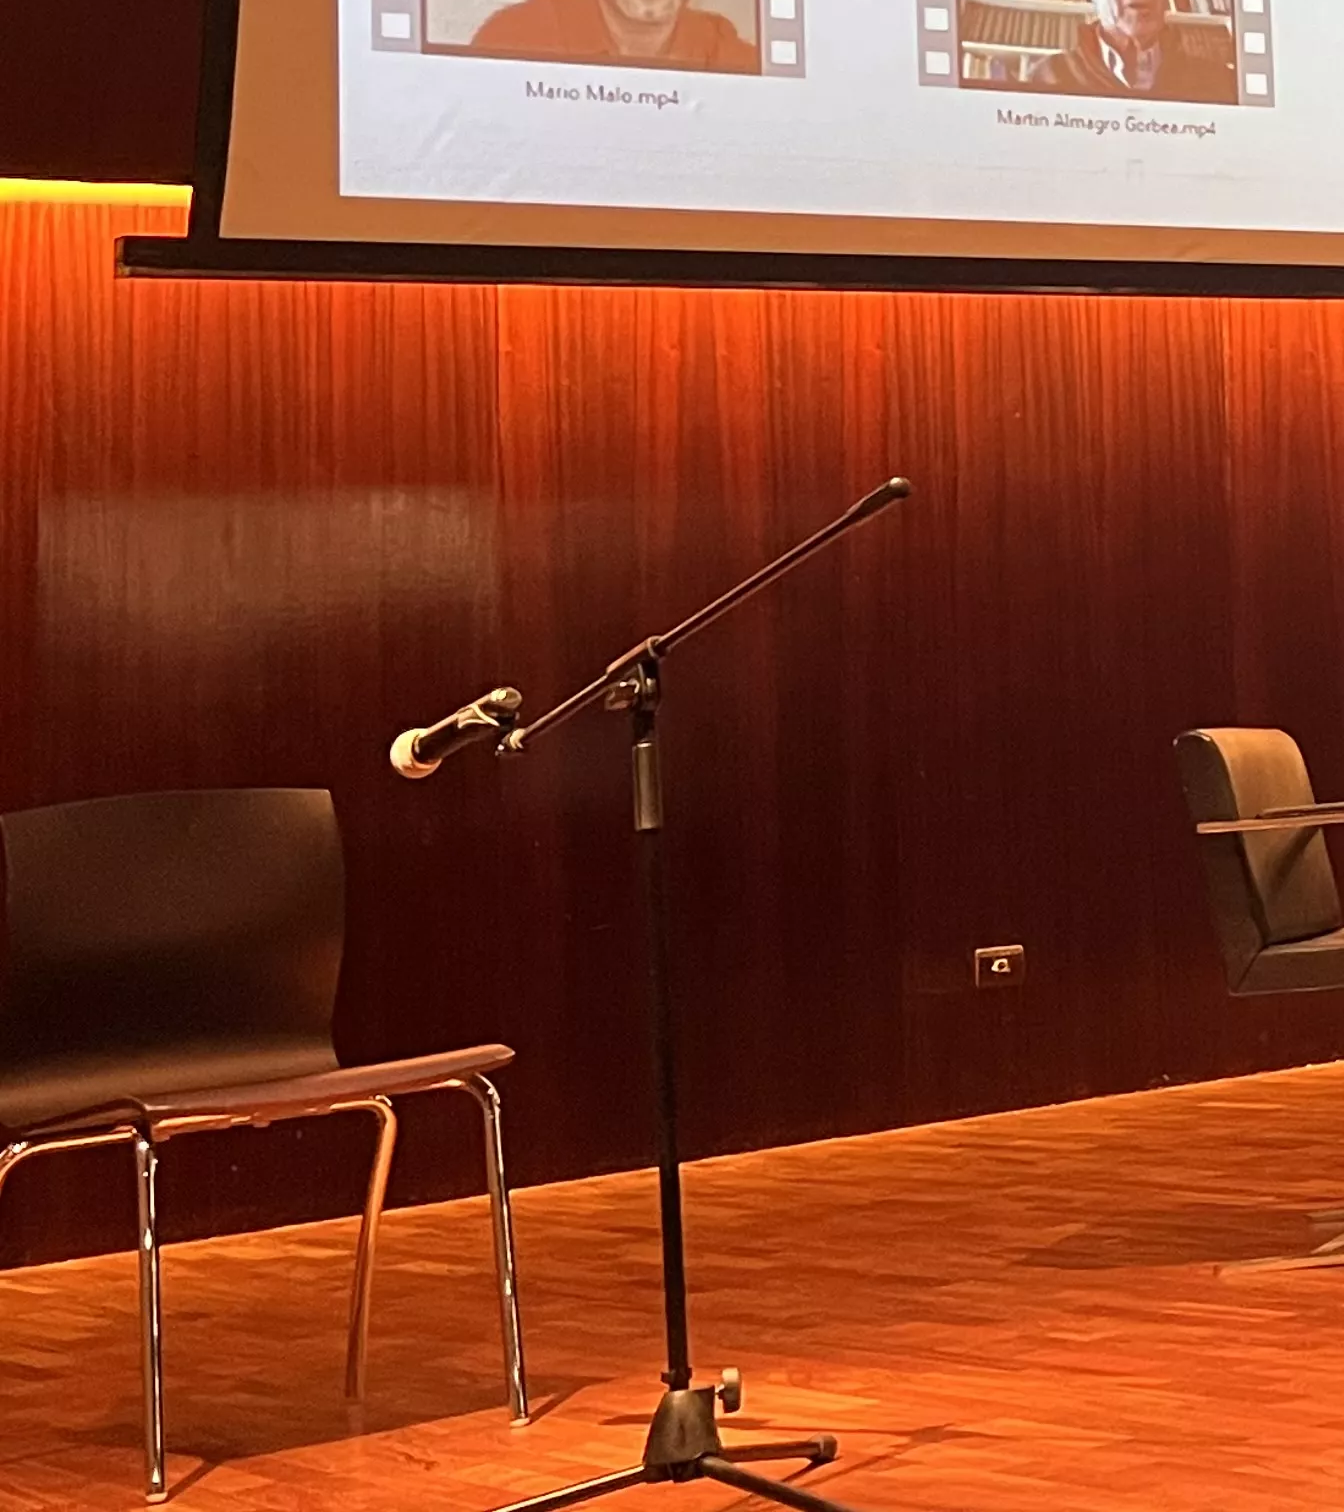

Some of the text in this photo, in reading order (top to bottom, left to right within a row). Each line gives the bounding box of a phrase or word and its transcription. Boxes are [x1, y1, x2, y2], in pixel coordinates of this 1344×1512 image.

[526, 80, 680, 110] Mario Malo.mp4
[1054, 112, 1121, 136] Almagro
